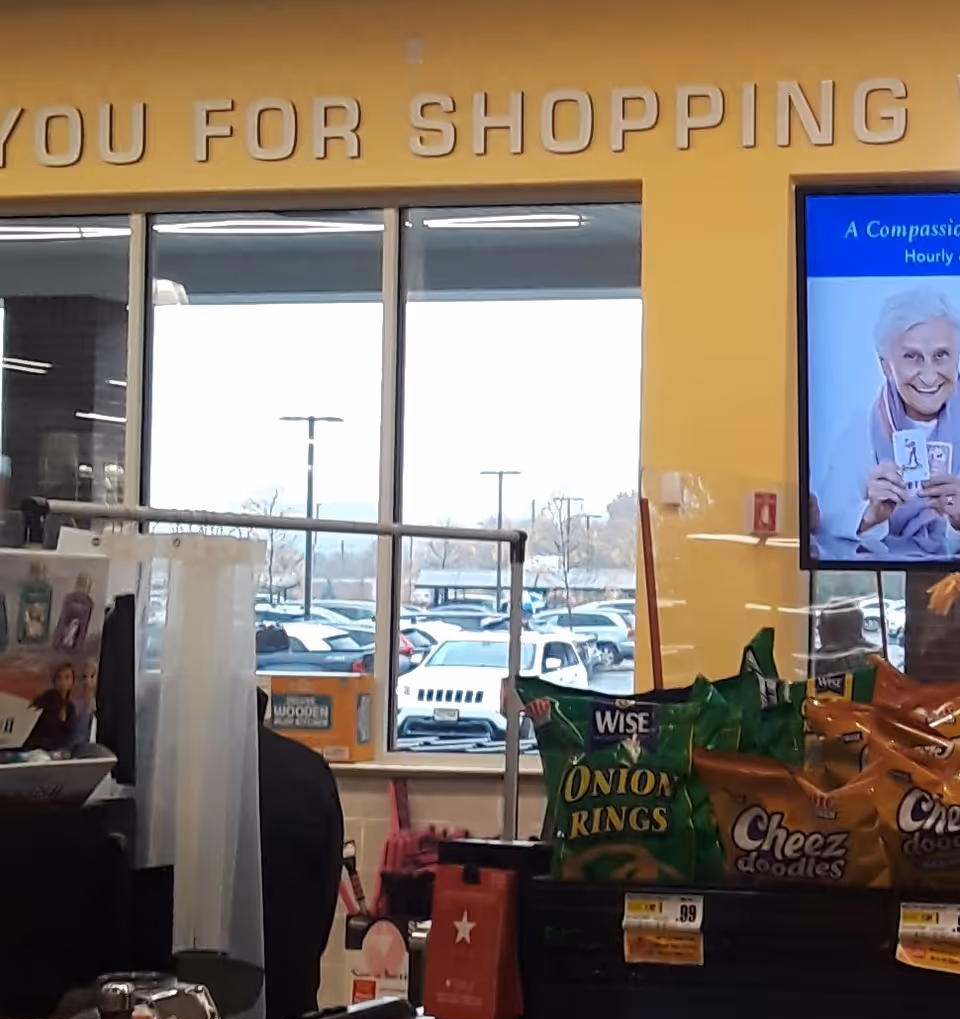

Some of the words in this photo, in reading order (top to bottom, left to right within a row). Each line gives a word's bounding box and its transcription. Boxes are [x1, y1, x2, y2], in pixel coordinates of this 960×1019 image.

[192, 97, 361, 162] FOR
[408, 79, 908, 158] SHOPPING
[844, 220, 859, 238] A
[905, 249, 953, 265] Hourly
[273, 705, 330, 718] WOODEN
[594, 709, 651, 734] WISE
[564, 765, 674, 803] ONION
[569, 807, 668, 839] RINGS
[732, 807, 848, 860] Cheez
[736, 850, 848, 881] doodles
[675, 904, 697, 923] .99
